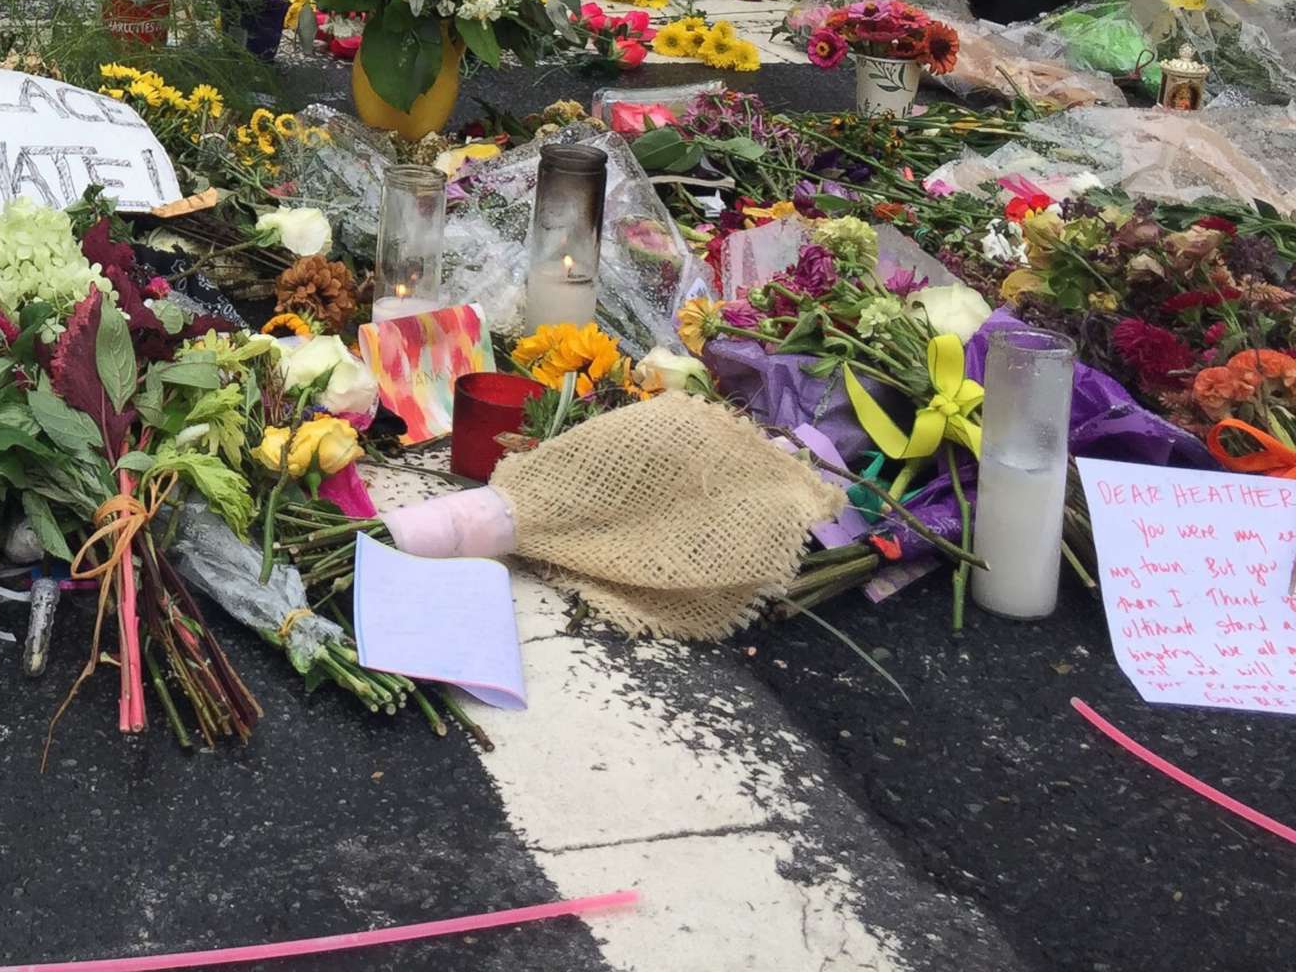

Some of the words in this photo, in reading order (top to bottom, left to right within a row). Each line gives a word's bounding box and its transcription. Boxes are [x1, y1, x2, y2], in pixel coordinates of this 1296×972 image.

[1097, 480, 1163, 506] DEAR
[1172, 484, 1296, 508] HEATHER
[1133, 517, 1165, 548] You
[1176, 525, 1218, 541] were
[1234, 529, 1267, 554] my
[1109, 566, 1141, 589] my
[1246, 561, 1278, 586] you
[1206, 588, 1265, 606] Thank
[1216, 614, 1268, 635] stand
